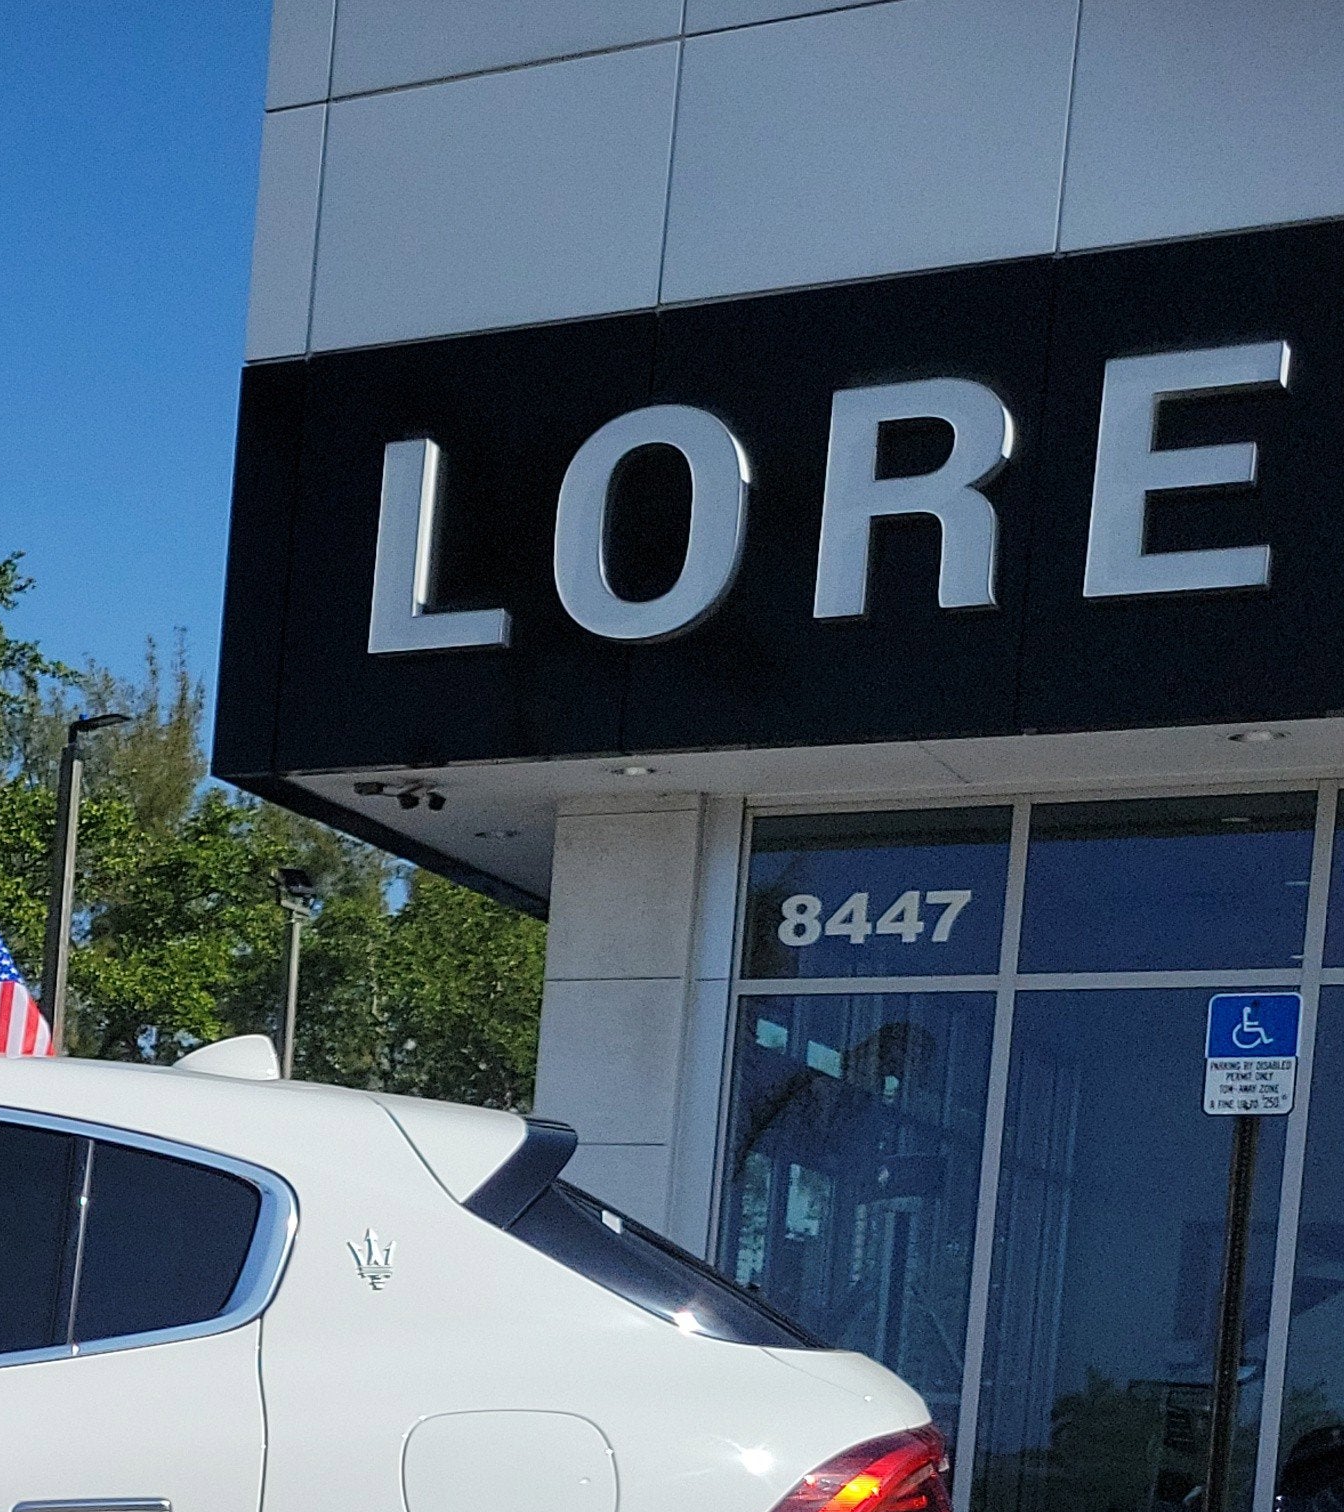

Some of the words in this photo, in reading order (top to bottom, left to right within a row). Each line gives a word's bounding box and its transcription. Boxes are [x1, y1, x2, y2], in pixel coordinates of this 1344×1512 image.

[368, 341, 1291, 653] LORE
[777, 889, 972, 947] 8447
[1256, 1060, 1292, 1070] DISABLED
